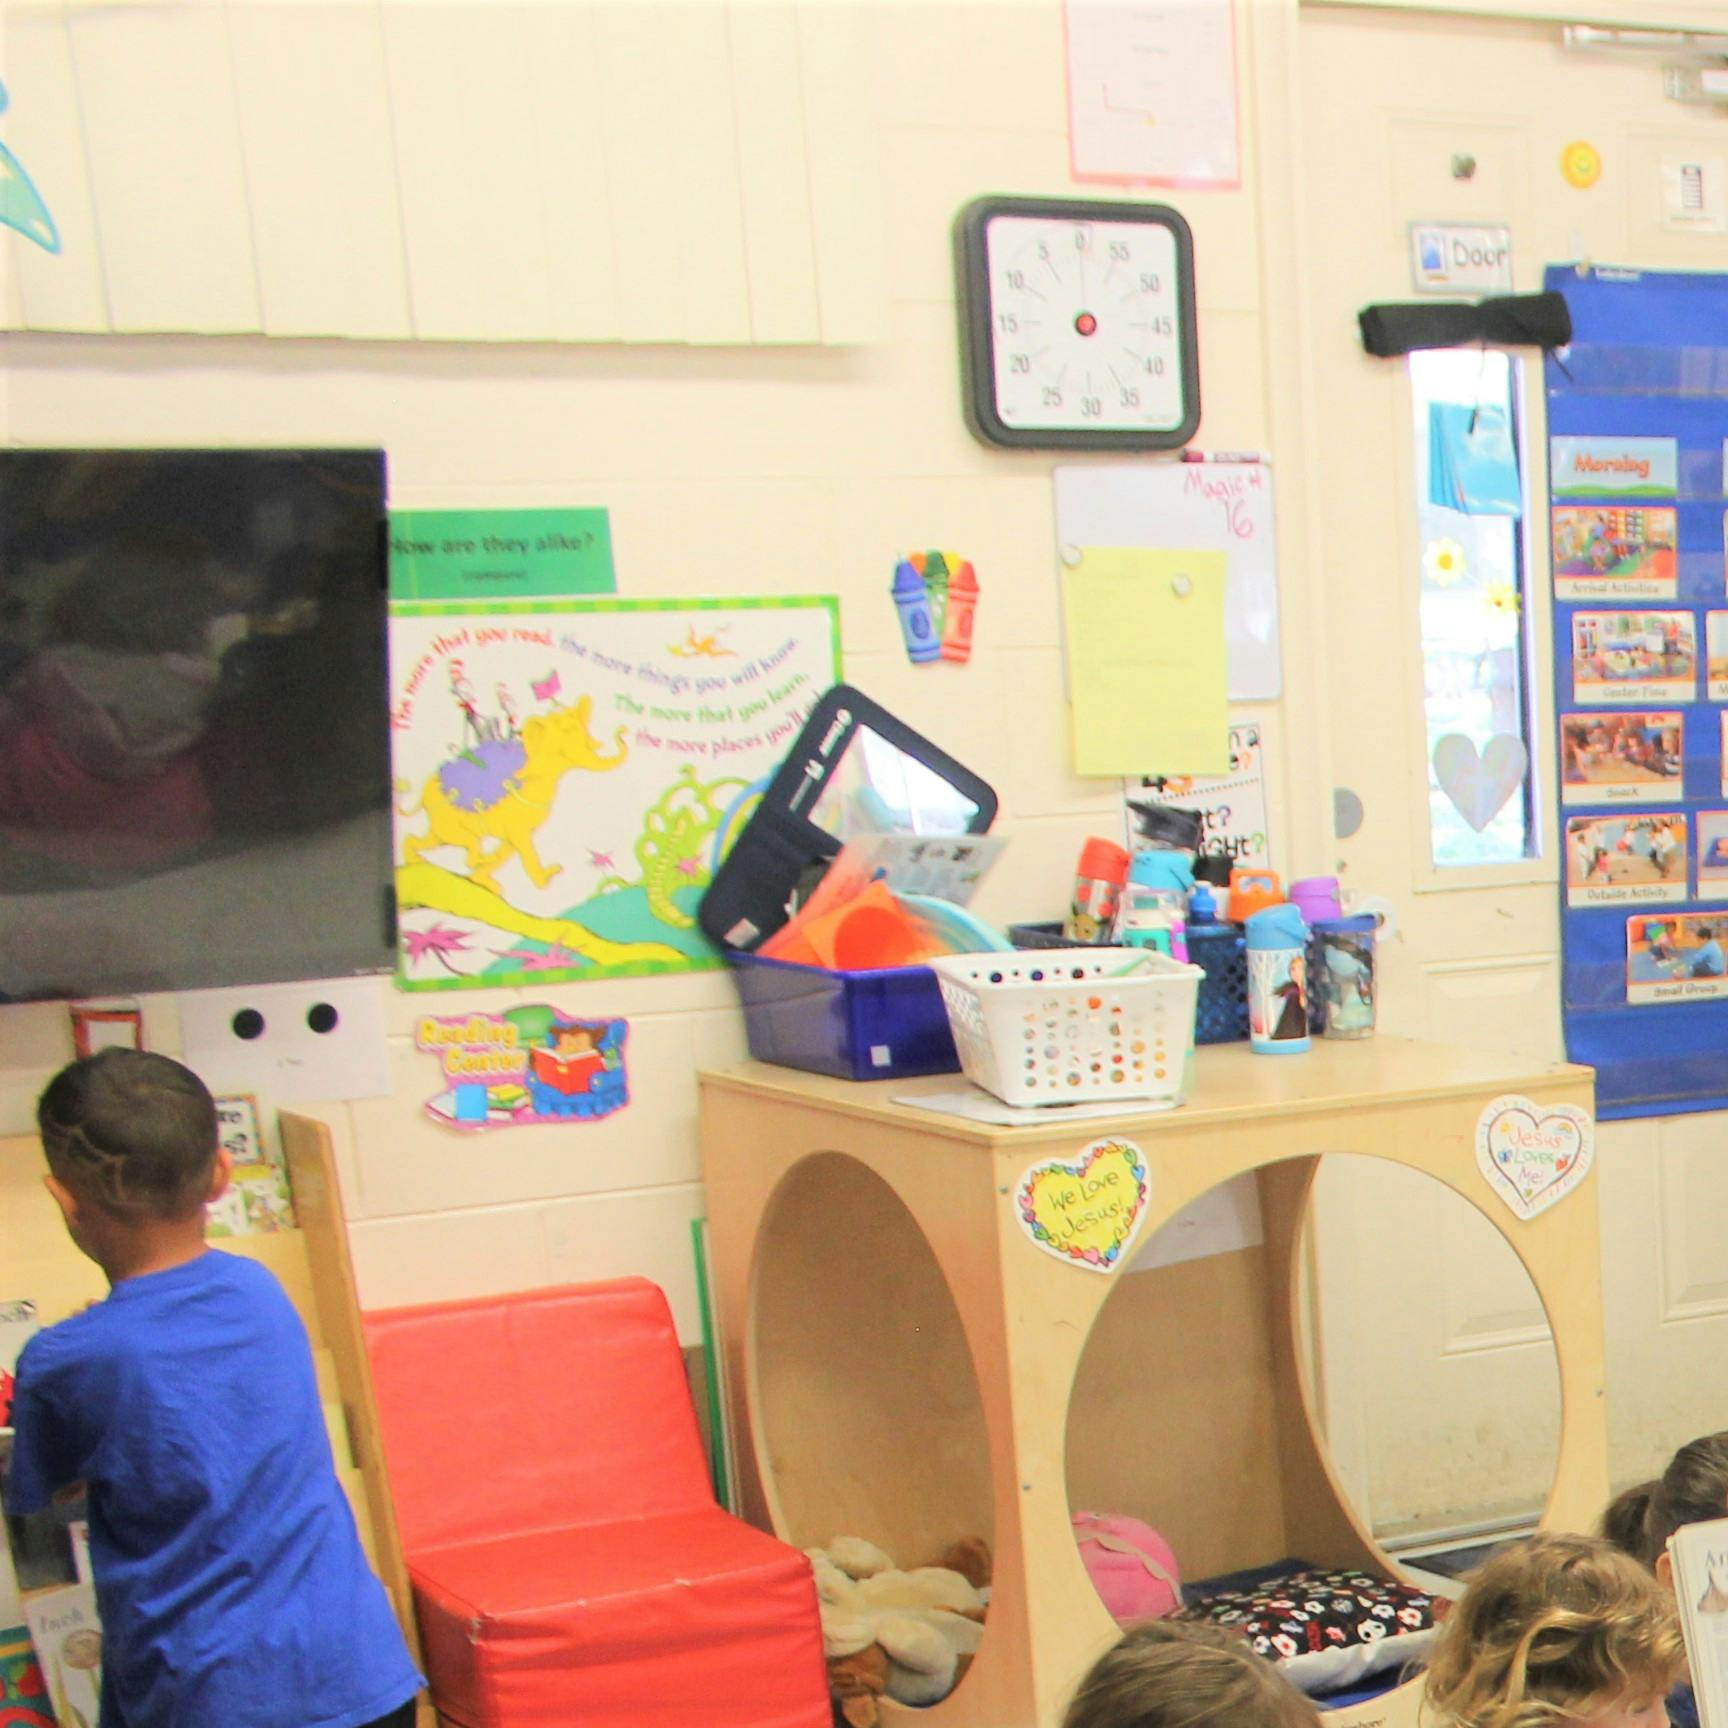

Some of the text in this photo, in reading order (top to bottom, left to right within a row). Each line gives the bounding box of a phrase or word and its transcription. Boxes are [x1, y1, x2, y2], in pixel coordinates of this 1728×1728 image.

[1038, 240, 1049, 260] 5
[1075, 231, 1085, 250] 0
[1109, 241, 1130, 261] 55
[1454, 240, 1507, 268] Door
[1006, 270, 1024, 289] 10
[1139, 274, 1160, 292] 50
[998, 313, 1018, 332] 15
[1152, 320, 1171, 336] 45
[1010, 354, 1030, 374] 20
[1145, 356, 1164, 375] 40
[1042, 387, 1063, 406] 25
[1081, 397, 1101, 416] 30
[1120, 388, 1140, 407] 35
[1573, 453, 1650, 478] Morning
[1183, 467, 1246, 501] Magic
[1221, 500, 1255, 540] 16
[442, 538, 475, 554] are
[481, 536, 528, 556] they
[536, 531, 594, 551] alike?
[417, 1017, 519, 1050] Reading
[446, 1048, 527, 1074] Center
[1509, 1127, 1563, 1149] Jesus
[1513, 1148, 1555, 1165] Loves
[1048, 1171, 1120, 1211] We Love
[1062, 1197, 1126, 1239] Jesus!
